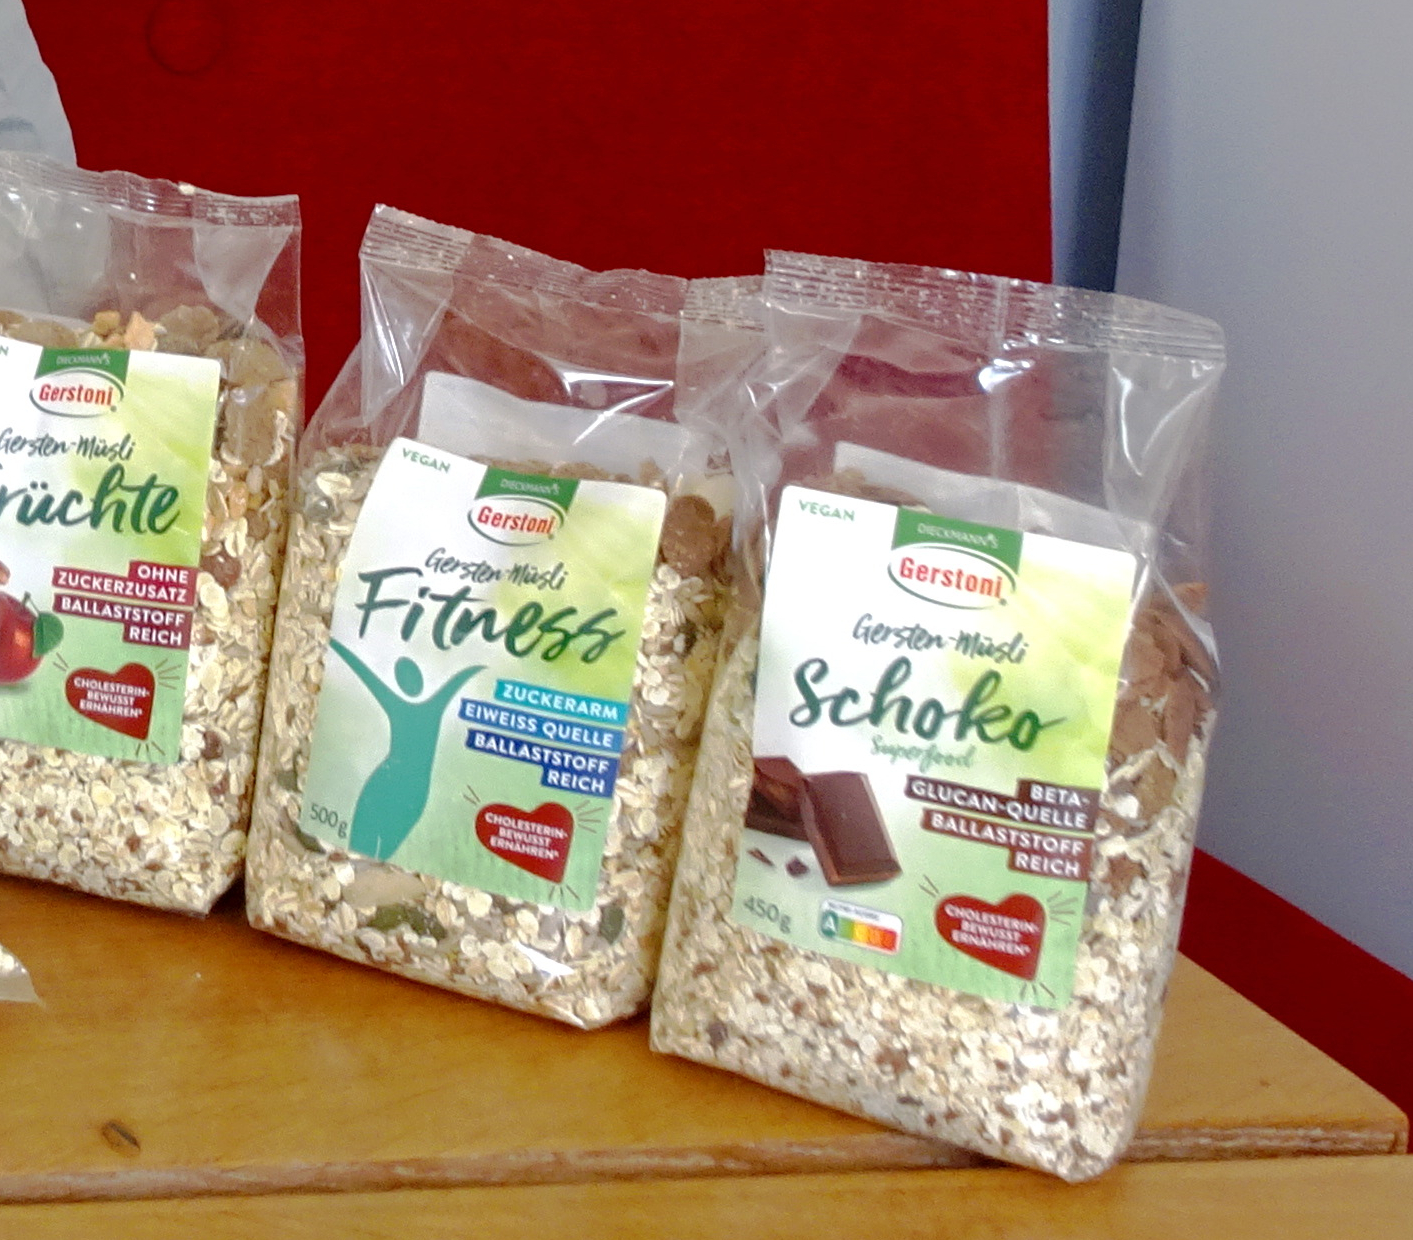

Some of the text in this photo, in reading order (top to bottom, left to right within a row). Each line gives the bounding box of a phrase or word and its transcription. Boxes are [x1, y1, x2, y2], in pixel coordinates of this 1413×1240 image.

[38, 383, 114, 408] Gerstoni
[402, 447, 451, 474] VEGAN
[477, 505, 555, 535] Gerstoni
[798, 499, 856, 522] VEGAN
[137, 564, 189, 584] OHNE
[424, 547, 569, 591] Gersten-Müsli
[899, 556, 1003, 600] Gerstoni
[58, 571, 188, 603] ZUCKERZUSATZ
[60, 597, 186, 626] BALLASTSTOFF
[355, 566, 626, 664] Fitness
[129, 625, 183, 647] REICH
[852, 612, 1030, 665] Gersten-Müsli
[73, 676, 151, 698] CHOLESTERIN-
[87, 690, 135, 706] BEWUSST
[502, 682, 618, 721] ZUCKERARM
[789, 656, 1068, 753] Schoko
[465, 703, 614, 749] EIWEISS QUELLE
[474, 734, 610, 774] BALLASTSTOFF
[870, 736, 977, 774] Superfood
[547, 768, 606, 794] REICH
[912, 781, 1087, 830] GLUCAN-QUELLE
[1030, 784, 1090, 808] BETA-
[309, 804, 348, 839] 500g
[484, 811, 569, 840] CHOLESTERIN-
[930, 812, 1085, 856] BALLASTSTOFF
[498, 826, 552, 848] BEWUSST
[1015, 852, 1080, 877] REICH
[744, 894, 793, 935] 450g
[824, 913, 837, 933] A
[960, 920, 1023, 943] BEWUSST
